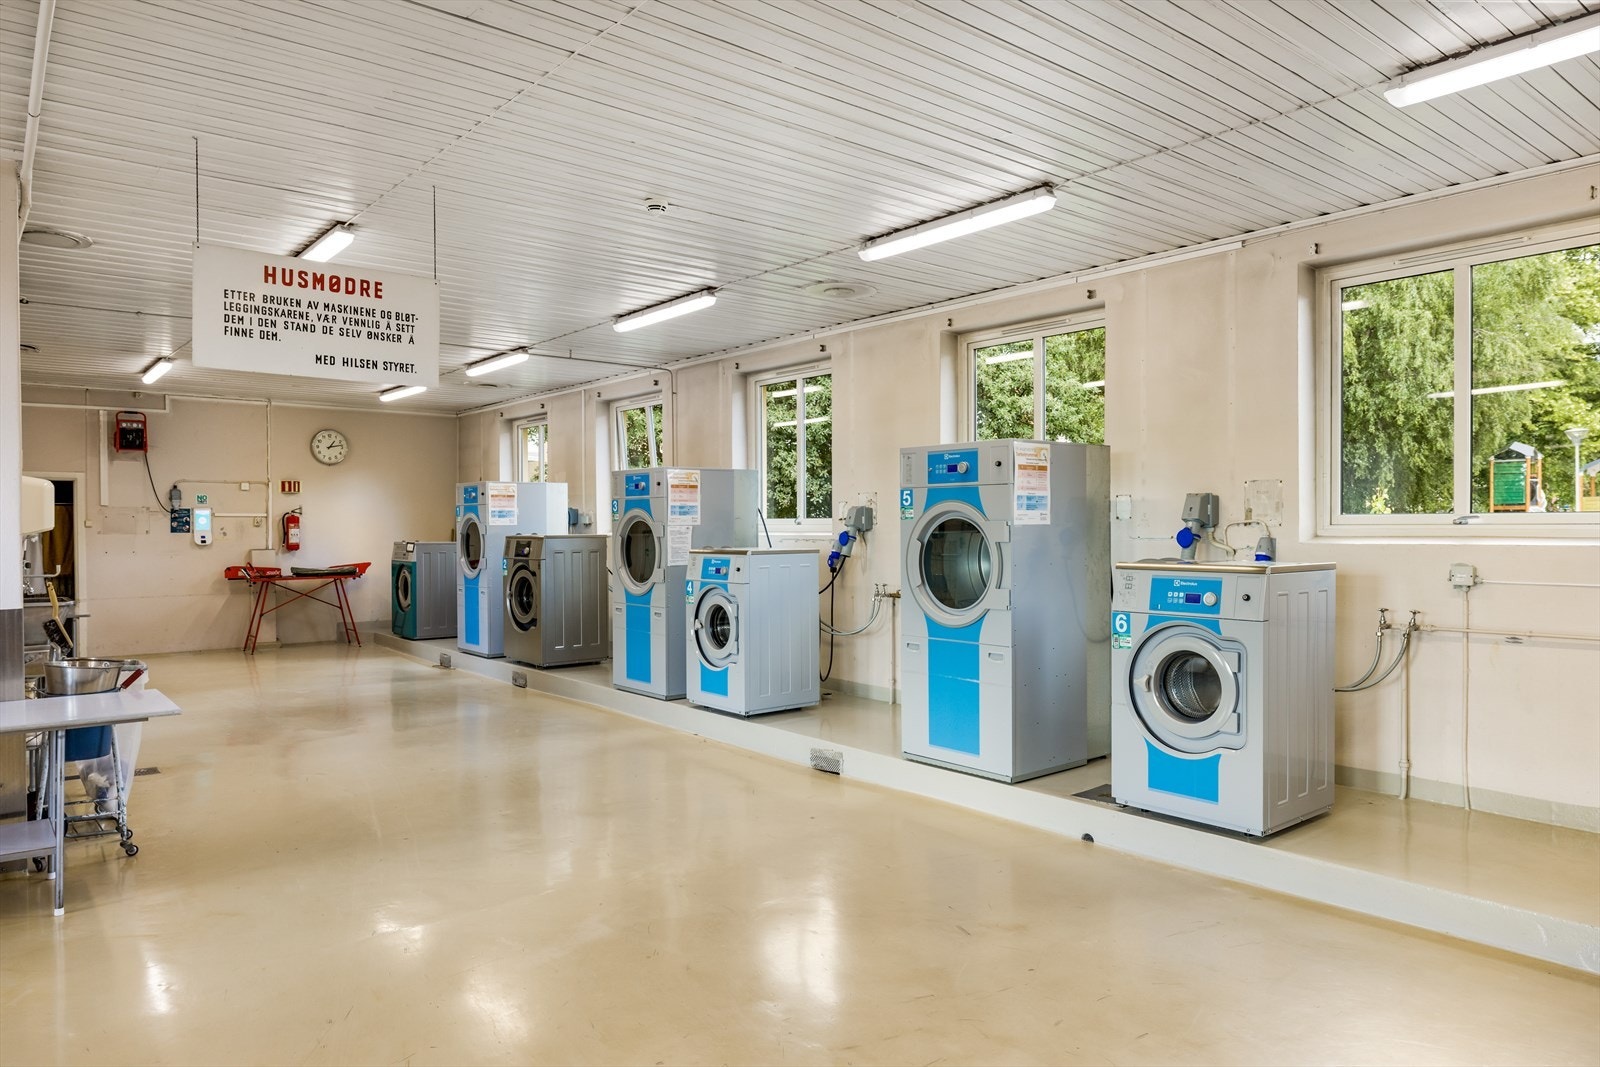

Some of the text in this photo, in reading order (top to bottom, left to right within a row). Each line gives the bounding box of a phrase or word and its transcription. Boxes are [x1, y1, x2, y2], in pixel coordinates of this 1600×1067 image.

[264, 265, 383, 299] HUSMØDRE
[224, 289, 256, 302] ETTER
[262, 295, 302, 308] BRUKEN
[307, 300, 319, 310] AV
[323, 302, 376, 318] MASKINENE
[380, 310, 392, 320] OG
[224, 301, 415, 334] LEGGINGSKARENE, VÆR VENNLIG Å SETT
[224, 314, 415, 345] DEM I DEN STAND DE SELV ØNSKER Å
[224, 326, 282, 342] FINNE DEM.
[315, 354, 417, 374] MED HILSEN STYRET.
[613, 501, 617, 511] 3
[903, 491, 911, 506] 5
[503, 559, 507, 569] 2
[687, 582, 692, 593] 4
[1115, 614, 1127, 632] 6
